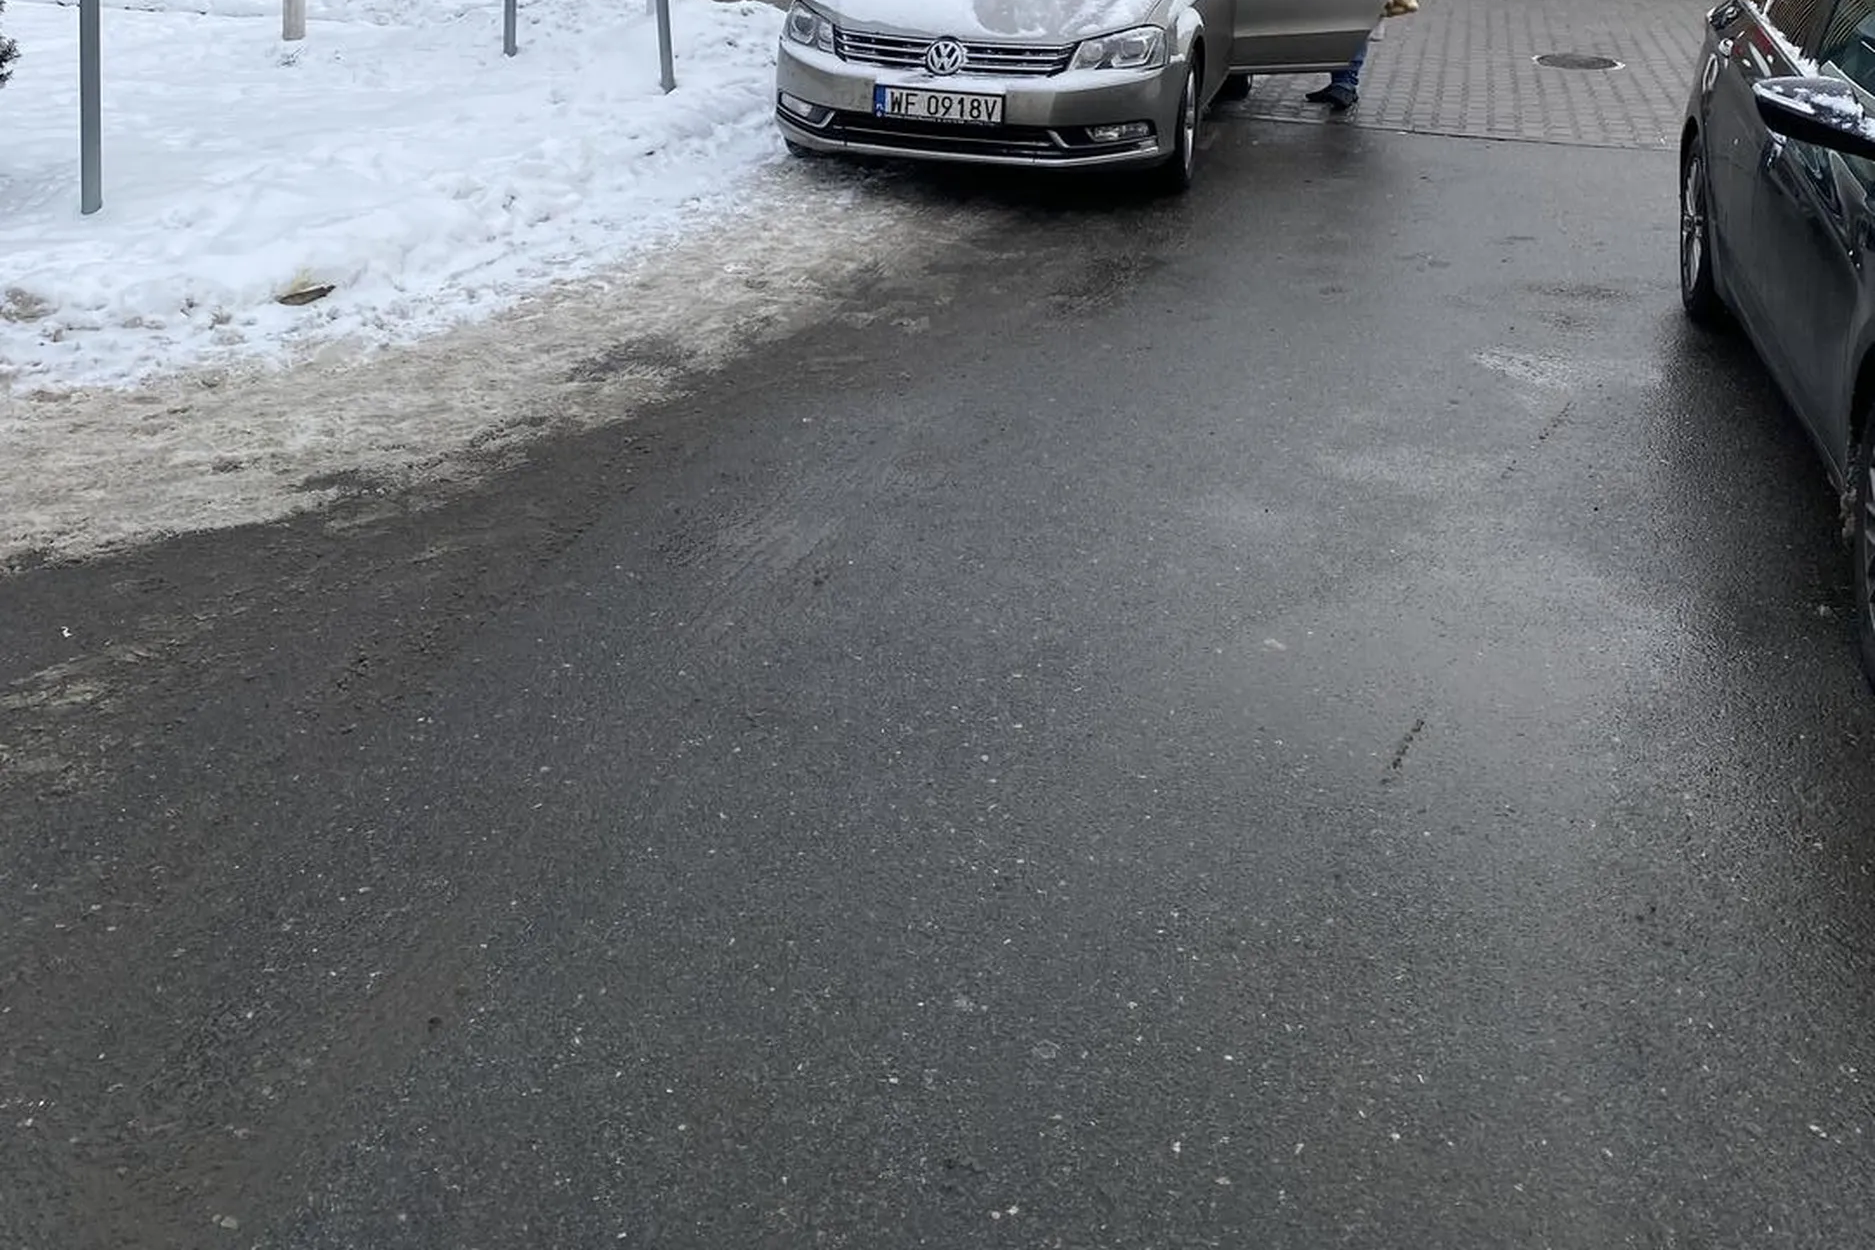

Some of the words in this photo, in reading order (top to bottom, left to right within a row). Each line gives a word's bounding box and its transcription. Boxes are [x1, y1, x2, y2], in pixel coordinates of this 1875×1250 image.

[929, 41, 961, 74] VW
[890, 91, 918, 115] WF
[926, 95, 998, 121] 0918V
